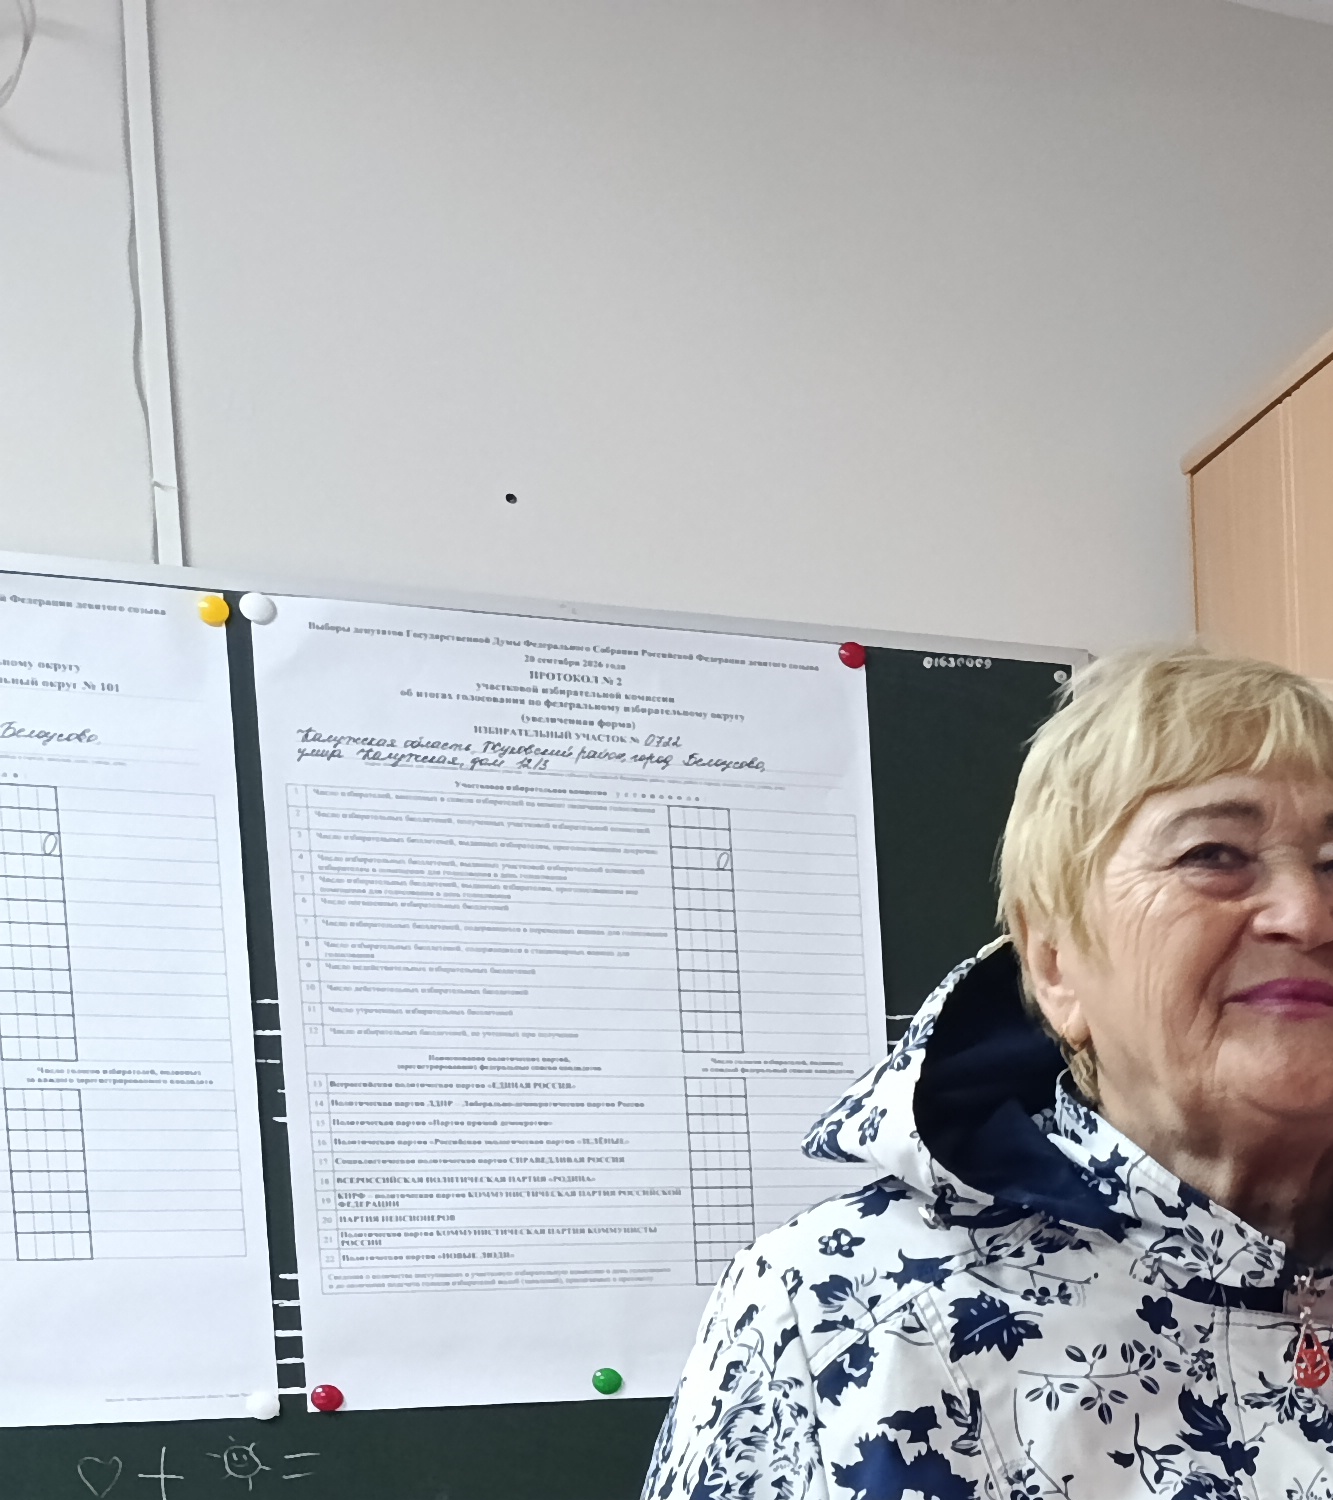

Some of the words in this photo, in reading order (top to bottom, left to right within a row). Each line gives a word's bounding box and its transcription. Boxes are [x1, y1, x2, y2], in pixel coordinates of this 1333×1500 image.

[530, 670, 599, 684] ПРОТОКОЛ
[616, 677, 623, 686] 2
[100, 682, 120, 693] 101
